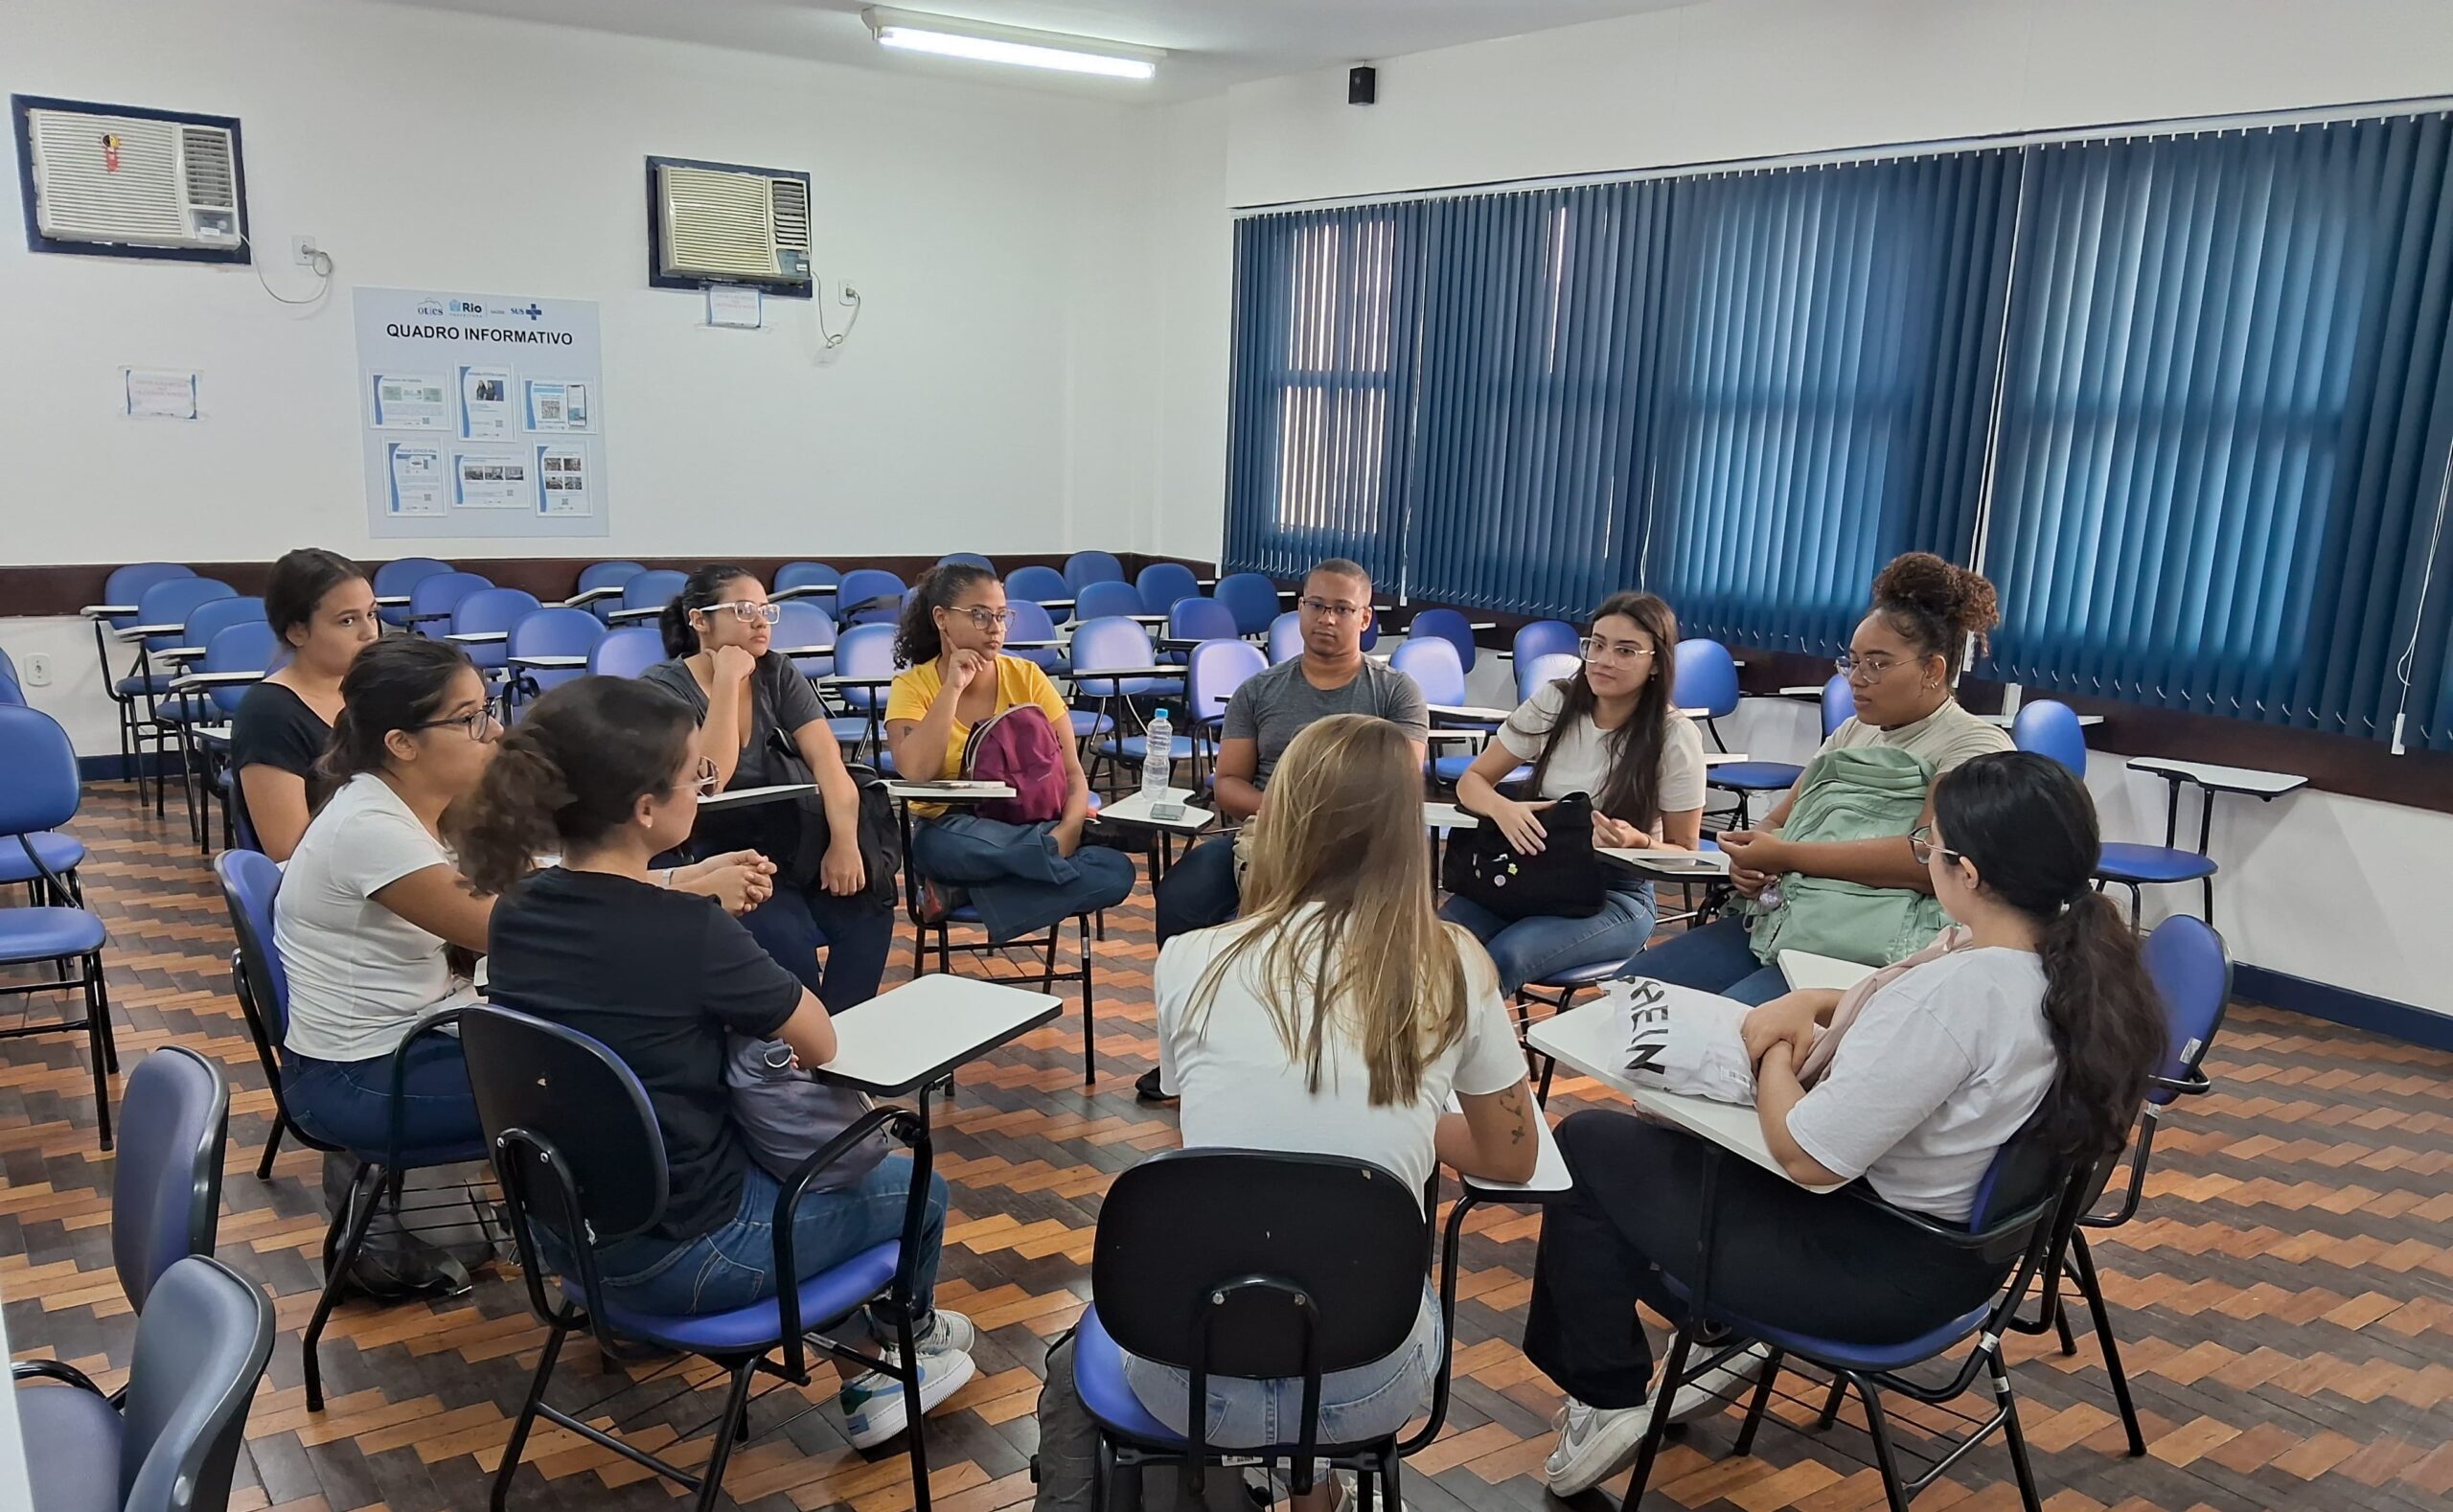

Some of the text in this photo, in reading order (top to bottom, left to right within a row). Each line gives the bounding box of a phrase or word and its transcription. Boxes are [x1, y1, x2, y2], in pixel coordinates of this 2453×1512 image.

[462, 302, 483, 313] Rio
[386, 323, 573, 346] QUADRO INFORMATIVO
